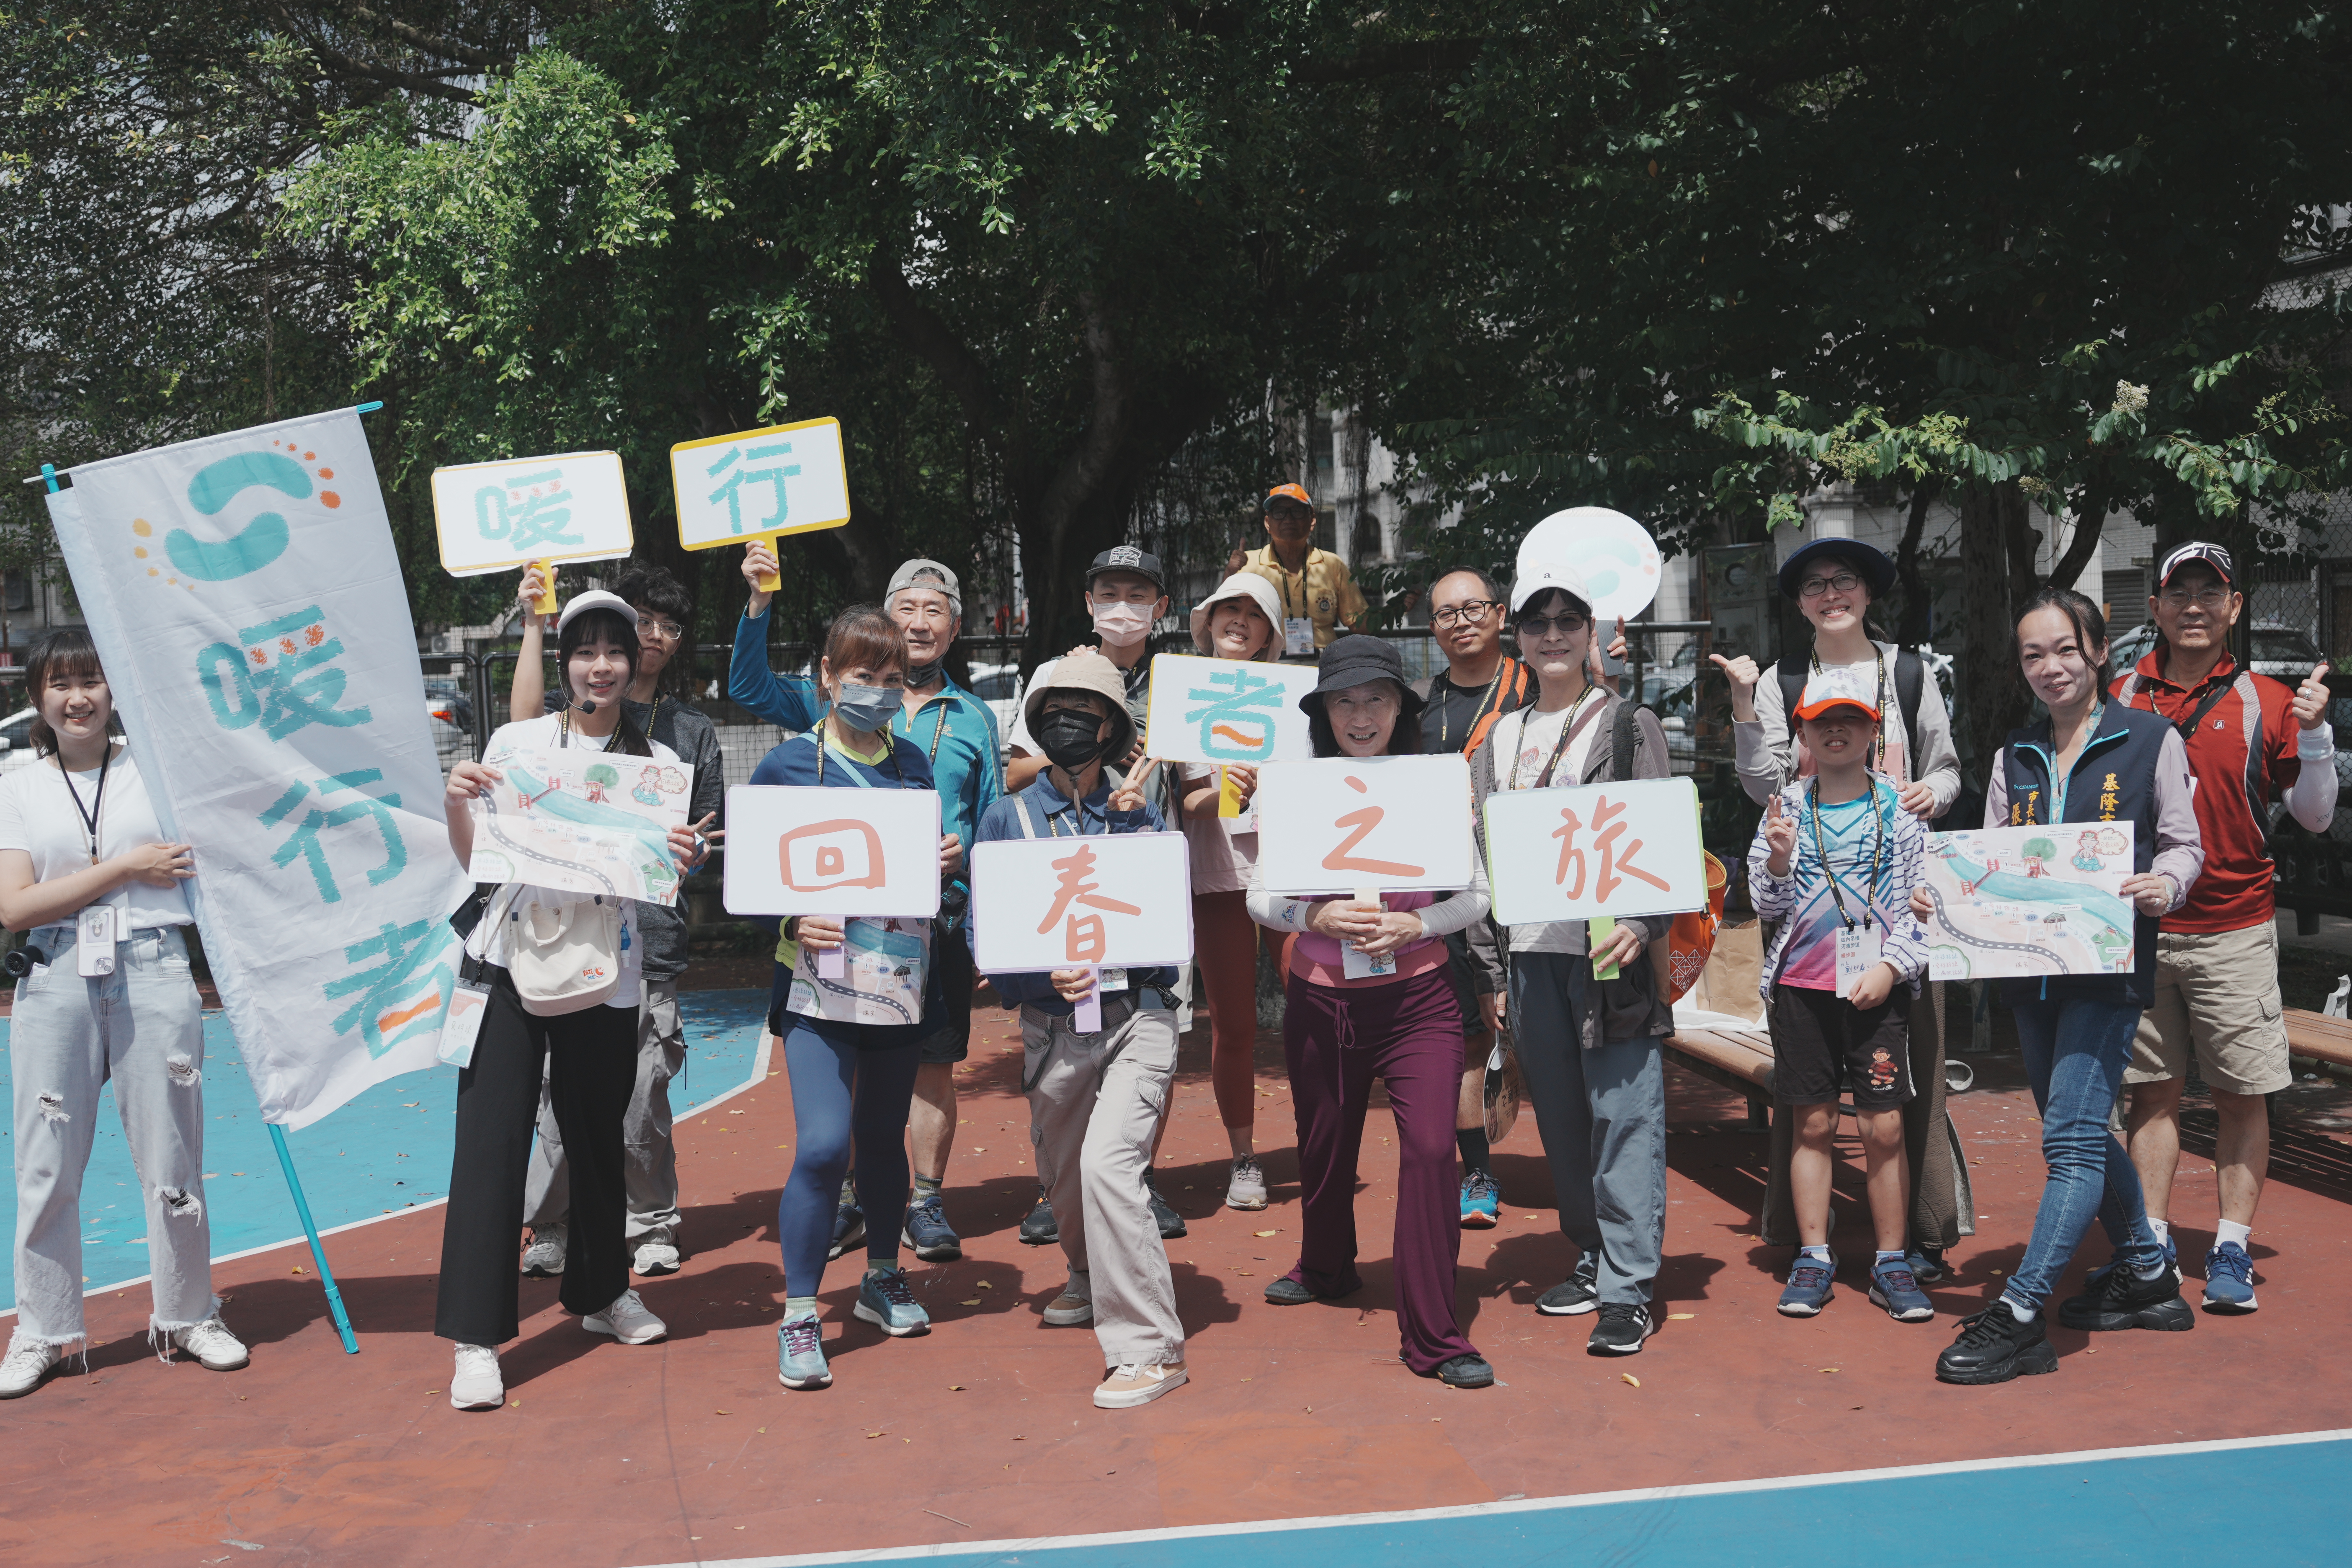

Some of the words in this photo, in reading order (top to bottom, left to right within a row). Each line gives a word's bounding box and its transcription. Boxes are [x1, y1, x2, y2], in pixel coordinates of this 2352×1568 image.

[474, 467, 584, 551] 暖
[706, 442, 802, 534] 行
[1184, 668, 1287, 761] 者
[779, 819, 886, 892] 回
[1321, 776, 1426, 877] 之
[1552, 795, 1670, 904] 旅
[1037, 843, 1142, 963] 春
